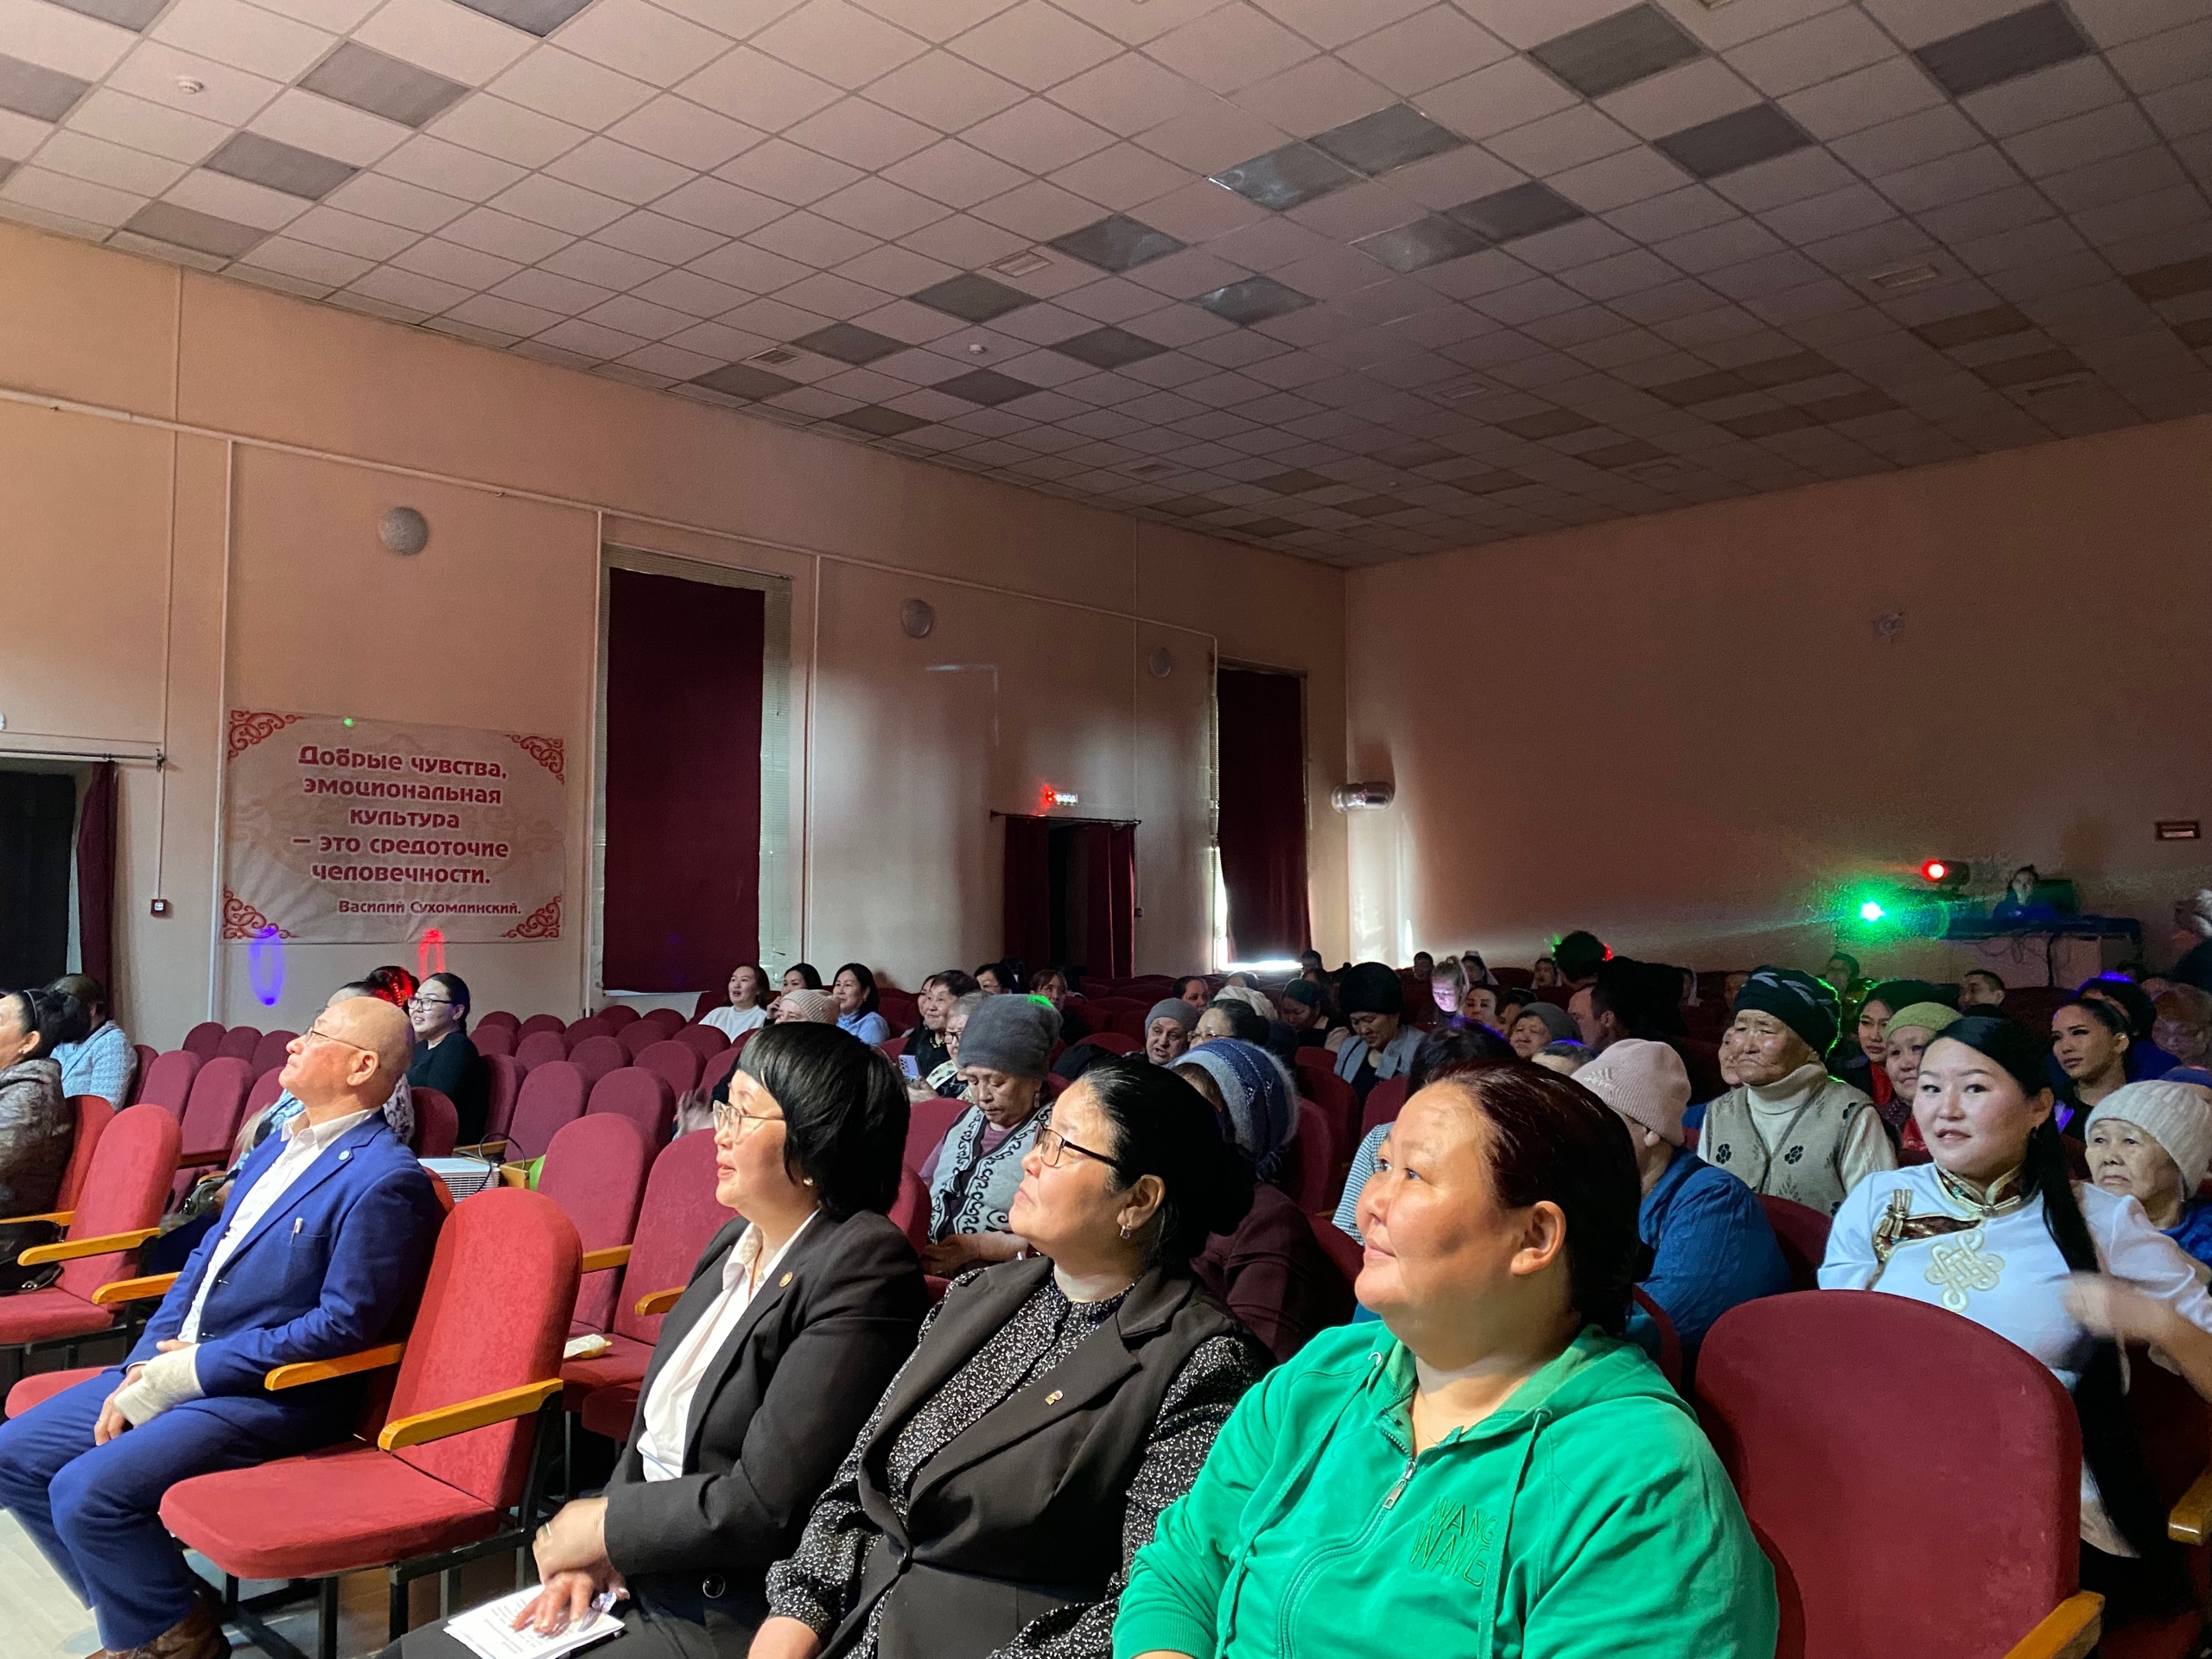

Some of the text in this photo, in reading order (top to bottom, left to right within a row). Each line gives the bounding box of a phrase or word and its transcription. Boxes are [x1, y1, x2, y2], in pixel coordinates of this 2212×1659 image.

[298, 746, 507, 779] Добрые чувства,
[303, 779, 502, 804] эмоциональная
[350, 809, 461, 829] культура
[320, 836, 360, 853] это
[369, 838, 509, 858] средоточие
[312, 864, 491, 885] человечности.
[339, 900, 522, 915] Василий Сухомлинский.
[1430, 1496, 1497, 1545] WANG
[1410, 1520, 1491, 1587] WANG
